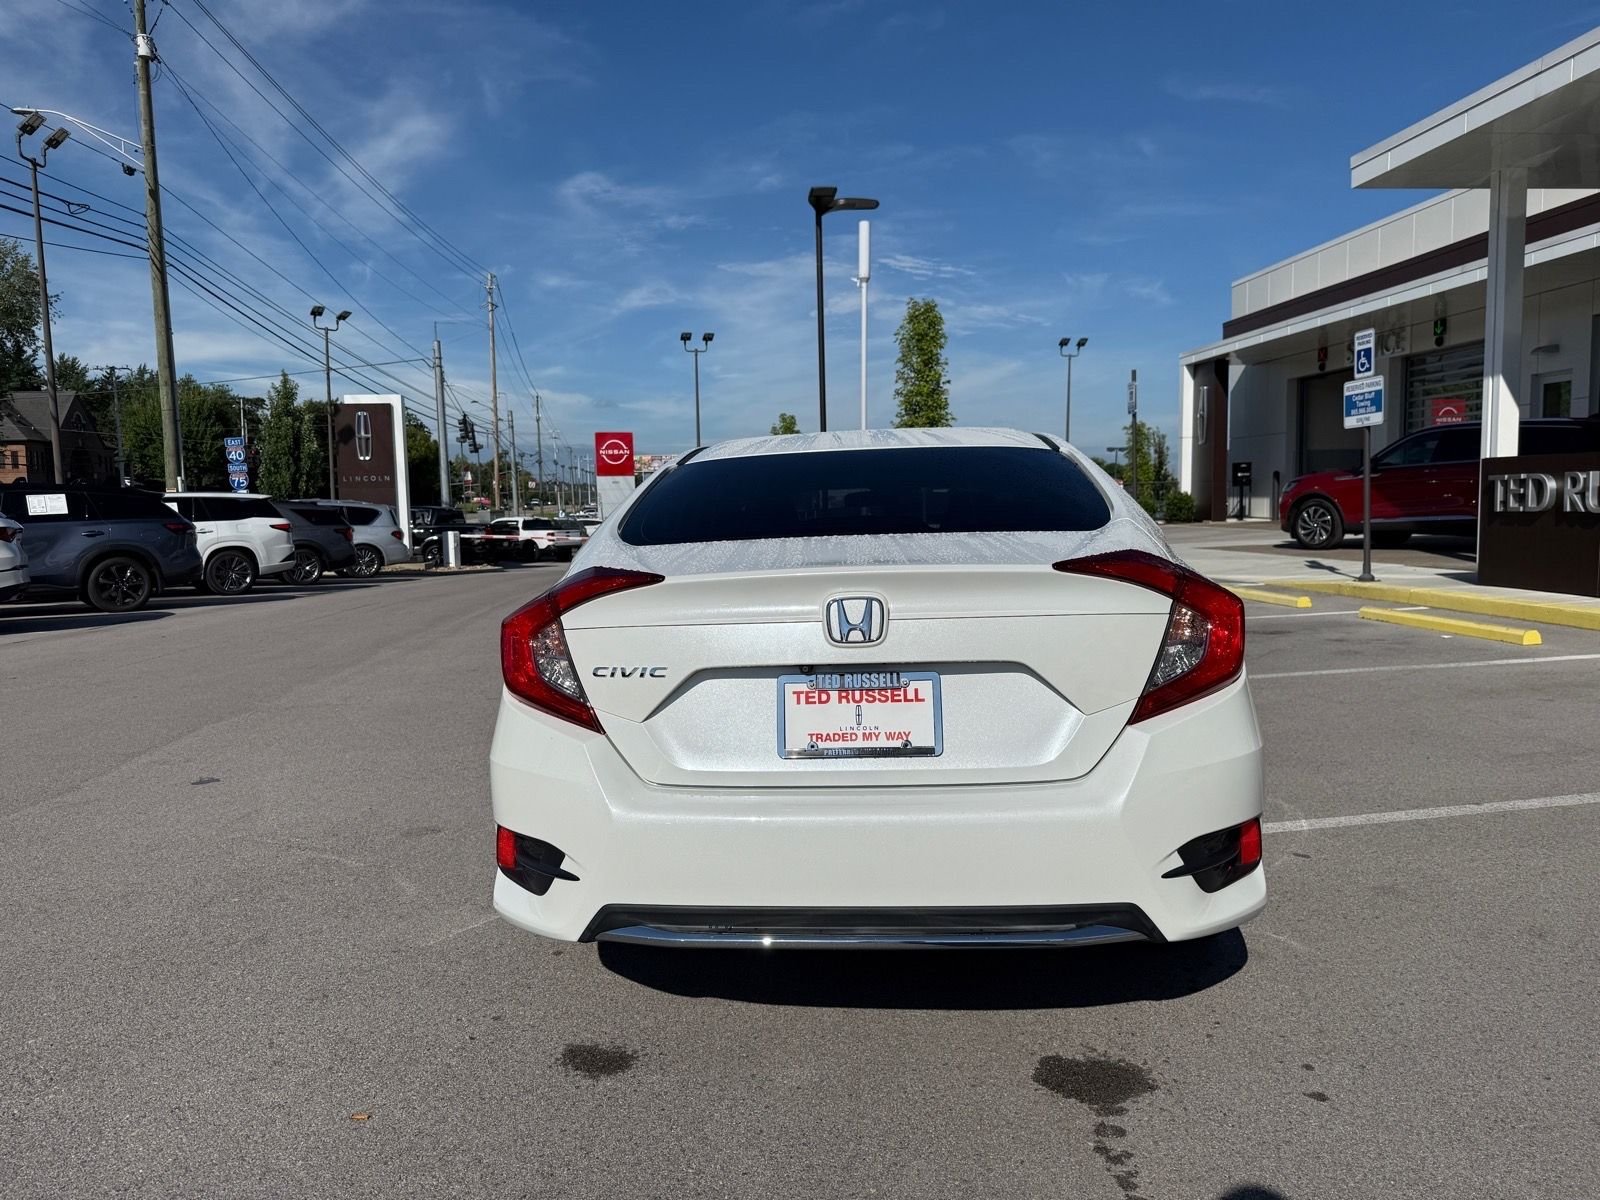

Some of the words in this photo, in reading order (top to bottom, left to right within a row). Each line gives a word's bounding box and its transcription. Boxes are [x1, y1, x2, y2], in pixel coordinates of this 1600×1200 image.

[229, 450, 244, 460] 40
[231, 477, 247, 487] 75
[1488, 473, 1557, 512] TED
[592, 666, 669, 678] CIVIC
[816, 674, 840, 689] TED
[844, 672, 900, 688] RUSSELL
[792, 690, 831, 705] TED
[838, 688, 926, 705] RUSSELL
[808, 732, 858, 743] TRADED
[862, 732, 881, 742] MY
[885, 731, 912, 742] WAY
